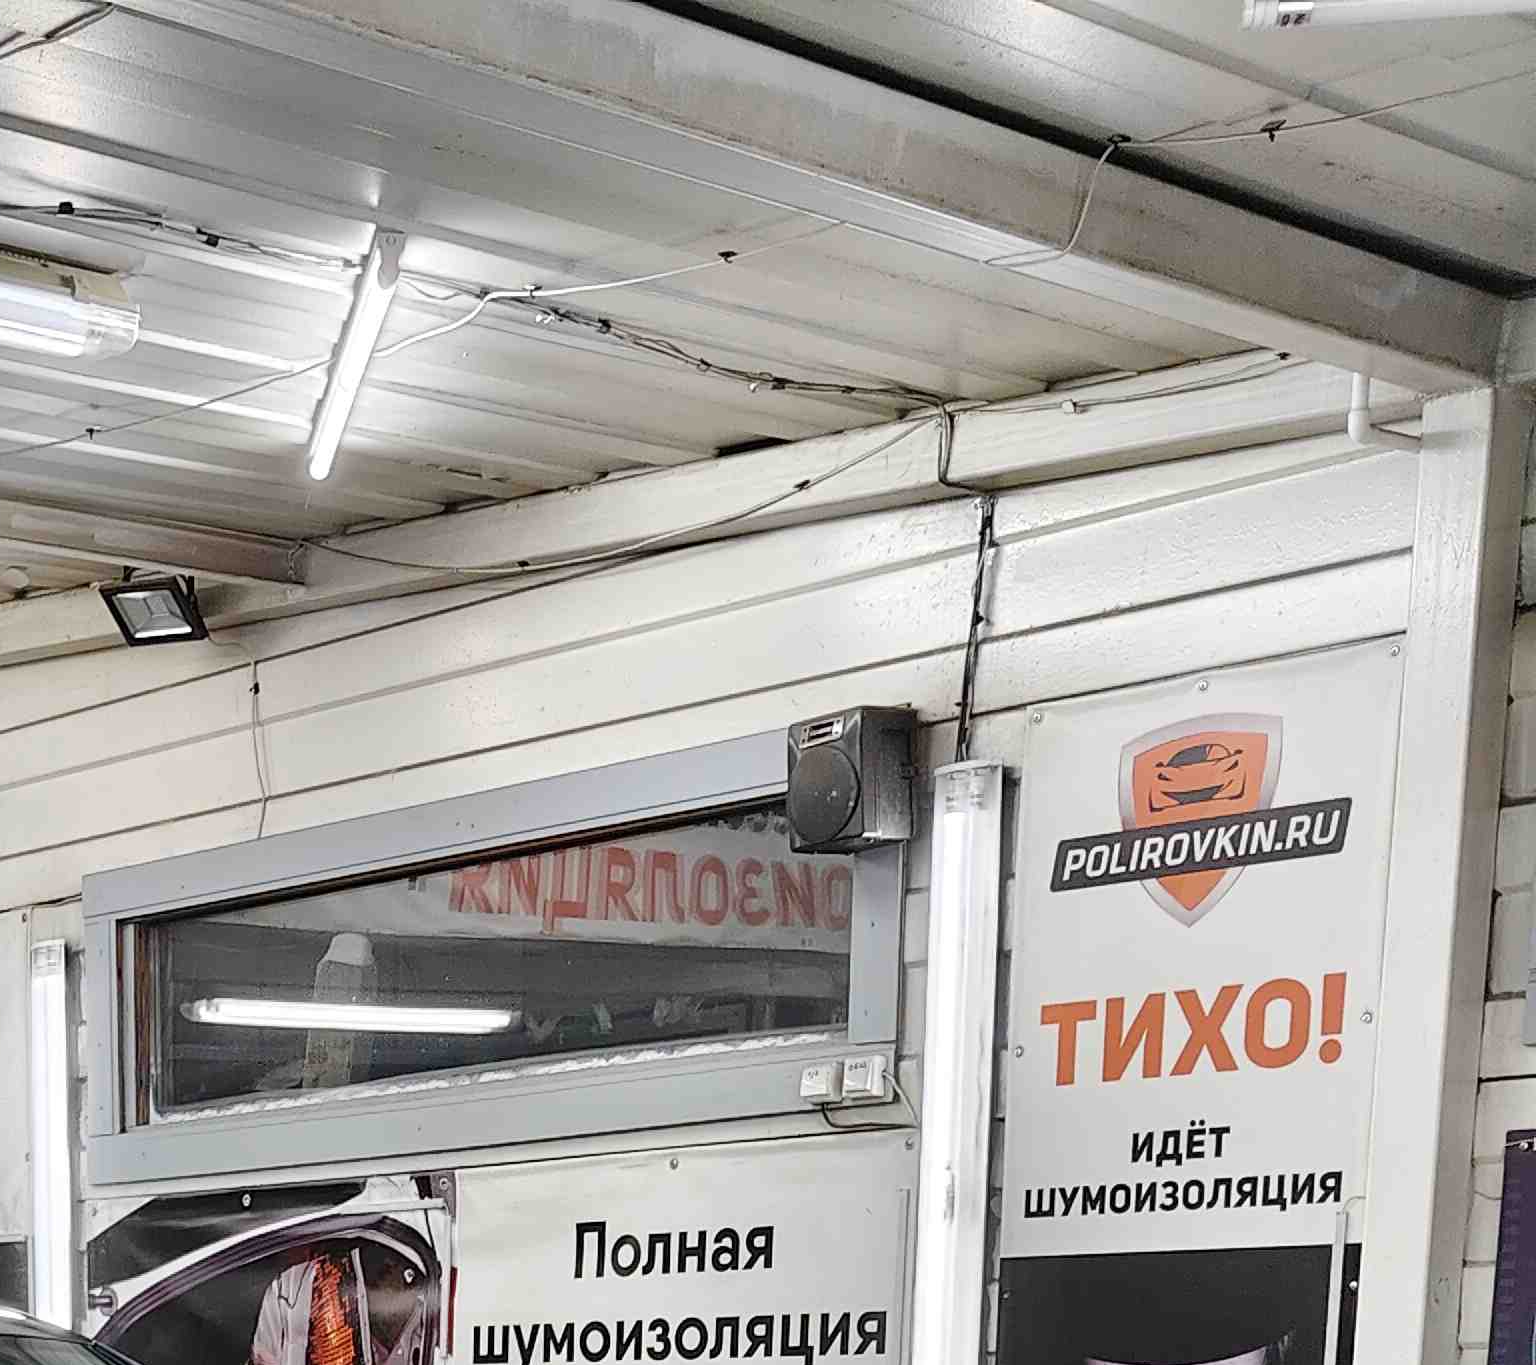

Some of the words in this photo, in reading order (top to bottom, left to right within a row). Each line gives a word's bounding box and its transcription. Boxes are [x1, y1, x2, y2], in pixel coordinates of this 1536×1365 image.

[1062, 809, 1343, 881] POLIROVKIN.RU
[1040, 972, 1347, 1086] ТИХО!
[1131, 1120, 1231, 1167] ИДЁТ
[1024, 1171, 1344, 1219] ШУМОИЗОЛЯЦИЯ
[574, 1221, 775, 1279] Полная
